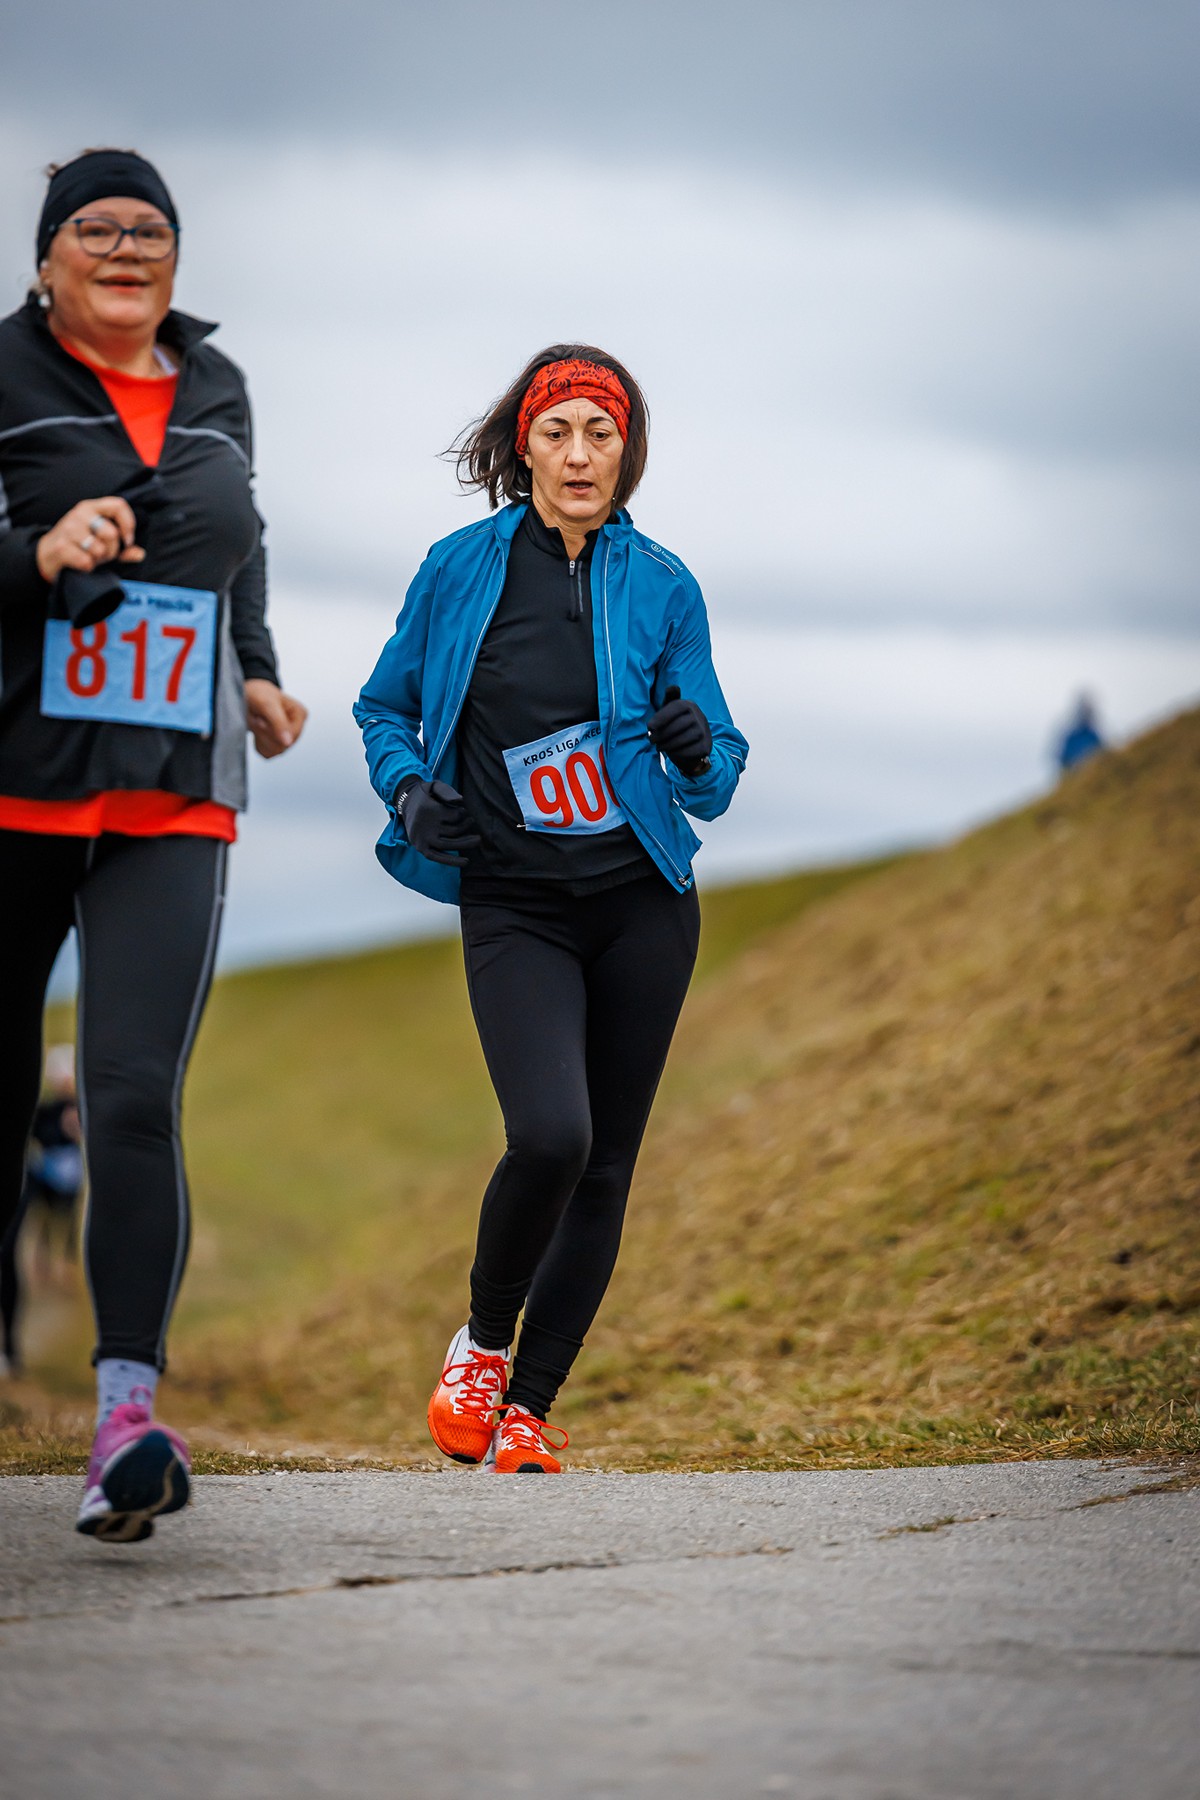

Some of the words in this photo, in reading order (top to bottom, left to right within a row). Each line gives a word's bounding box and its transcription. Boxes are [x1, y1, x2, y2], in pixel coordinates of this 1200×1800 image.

[66, 619, 196, 703] 817
[523, 747, 553, 766] KROS
[556, 738, 579, 753] LIGA
